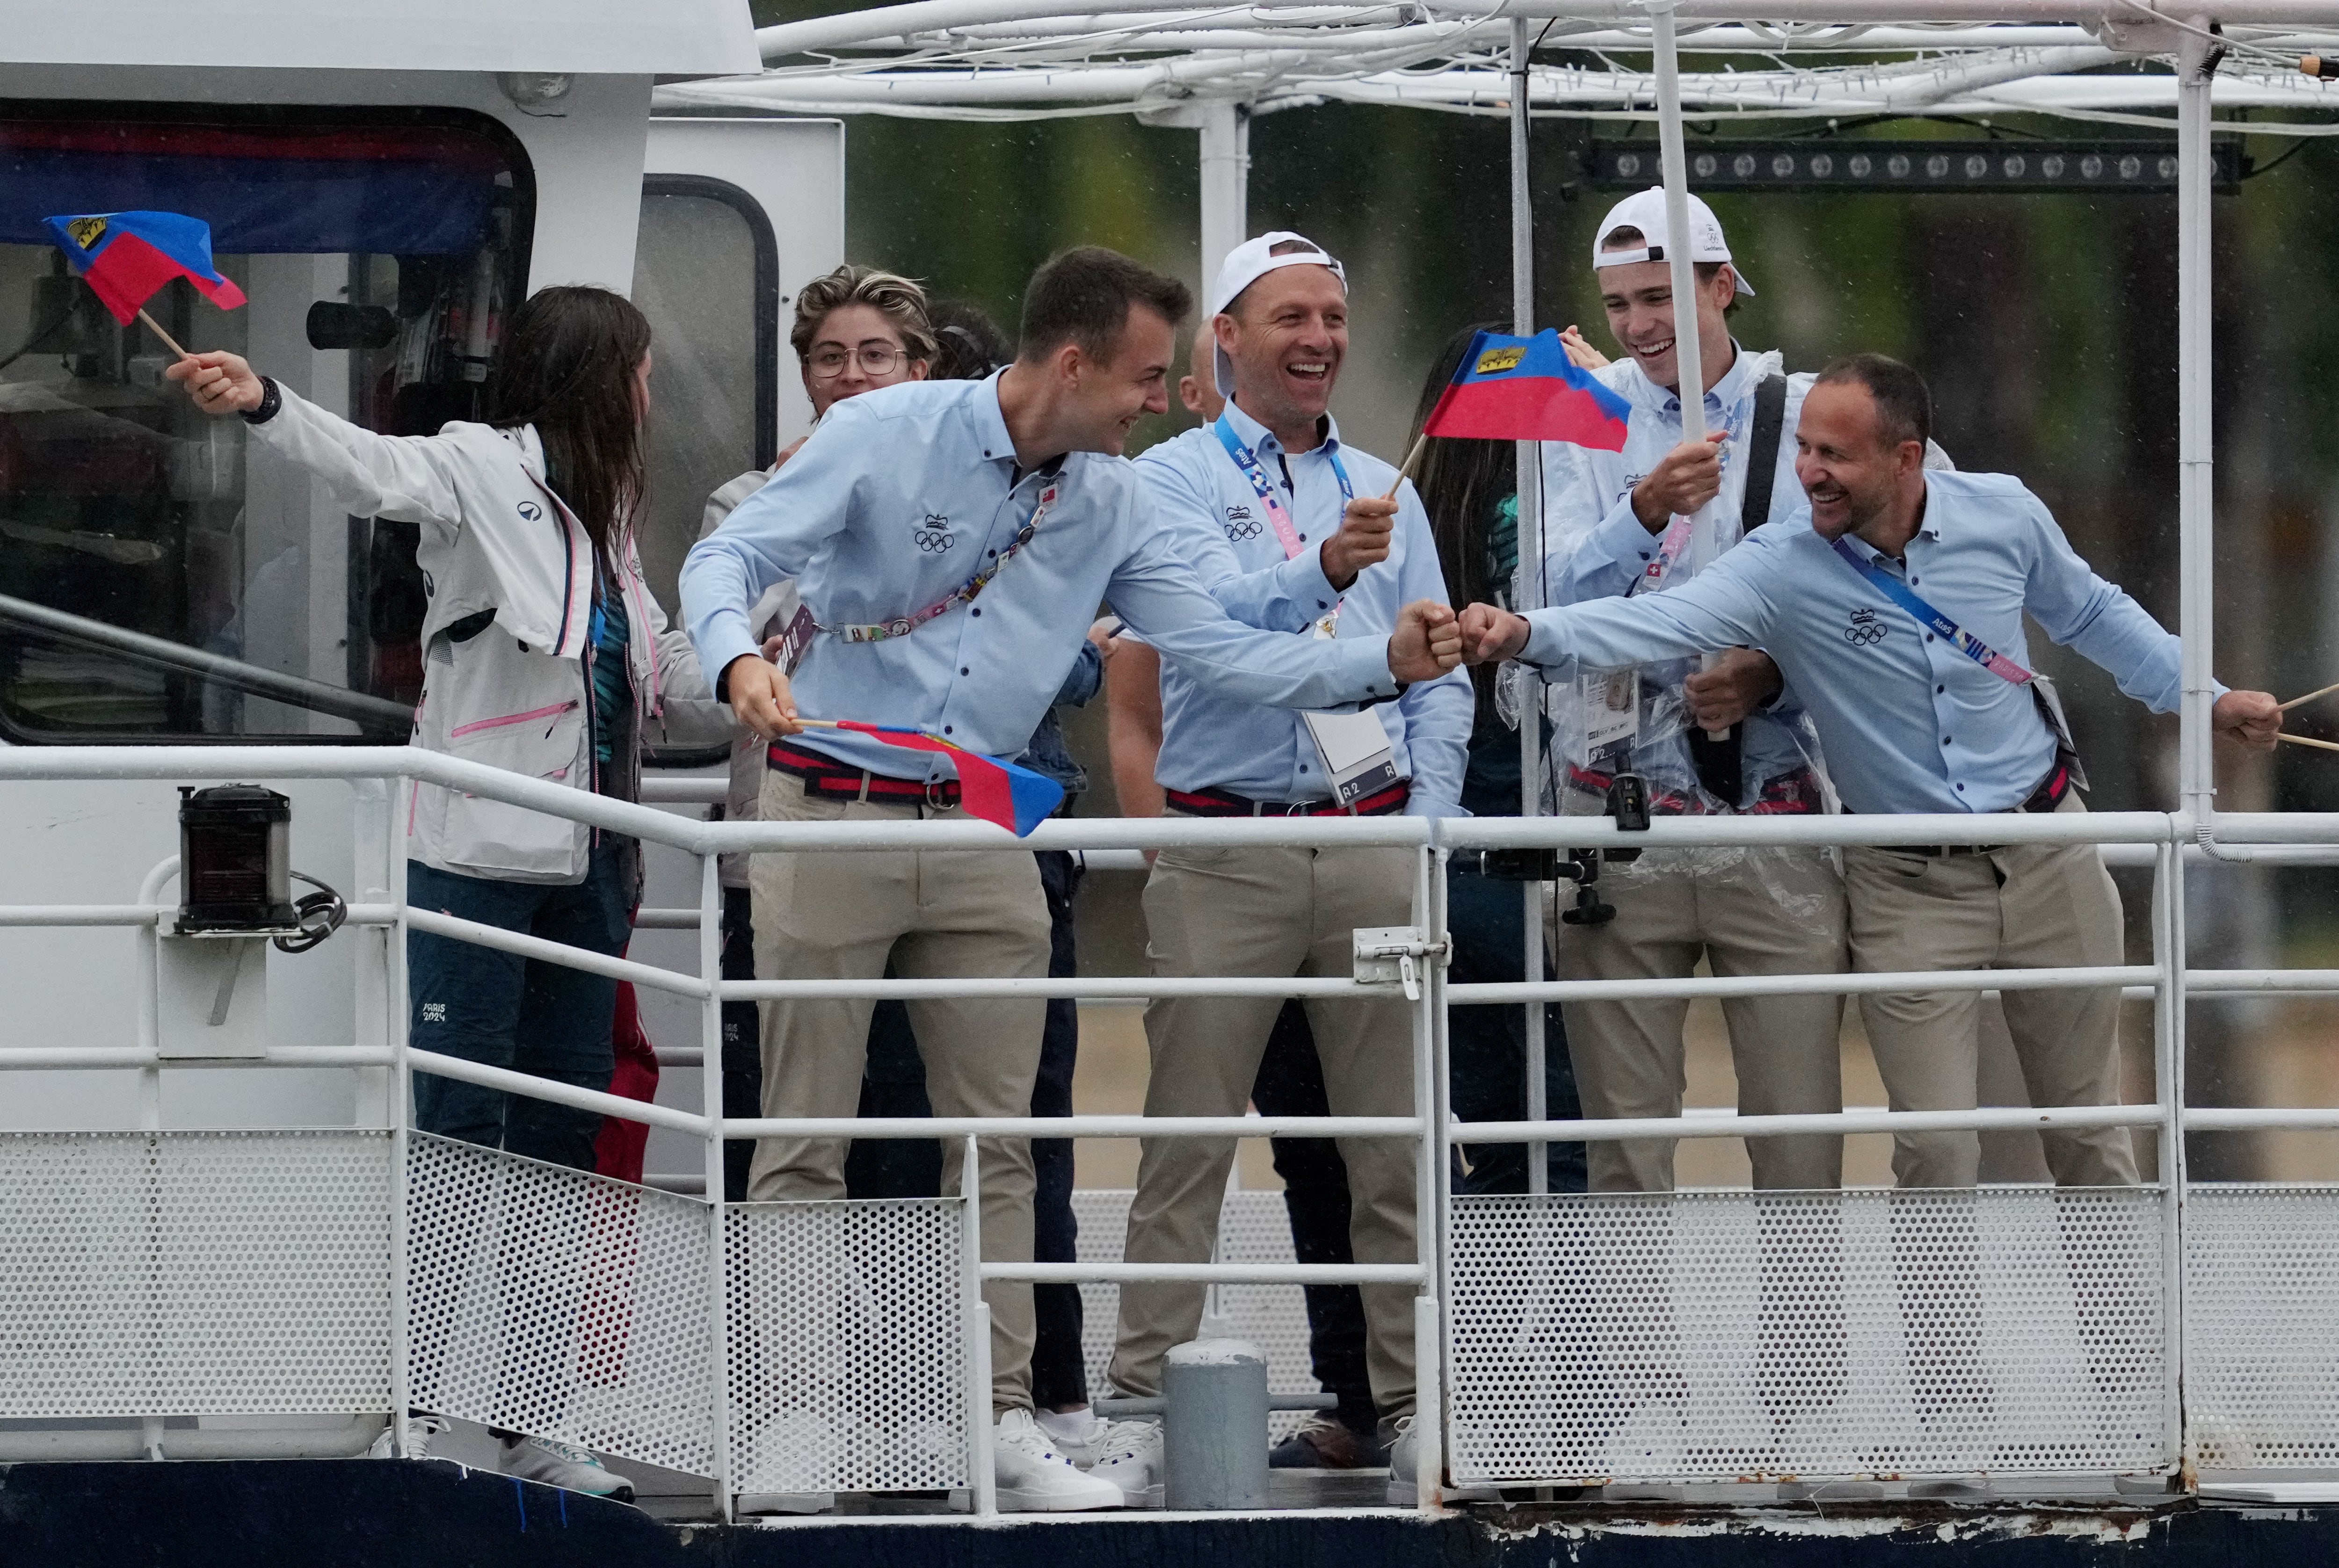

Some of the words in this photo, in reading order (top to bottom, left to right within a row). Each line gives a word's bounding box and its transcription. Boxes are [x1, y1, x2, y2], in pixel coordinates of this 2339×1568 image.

[1235, 448, 1251, 465] Atos
[1932, 618, 1952, 634] Atos
[1385, 765, 1395, 777] R
[423, 1012, 445, 1022] 2024
